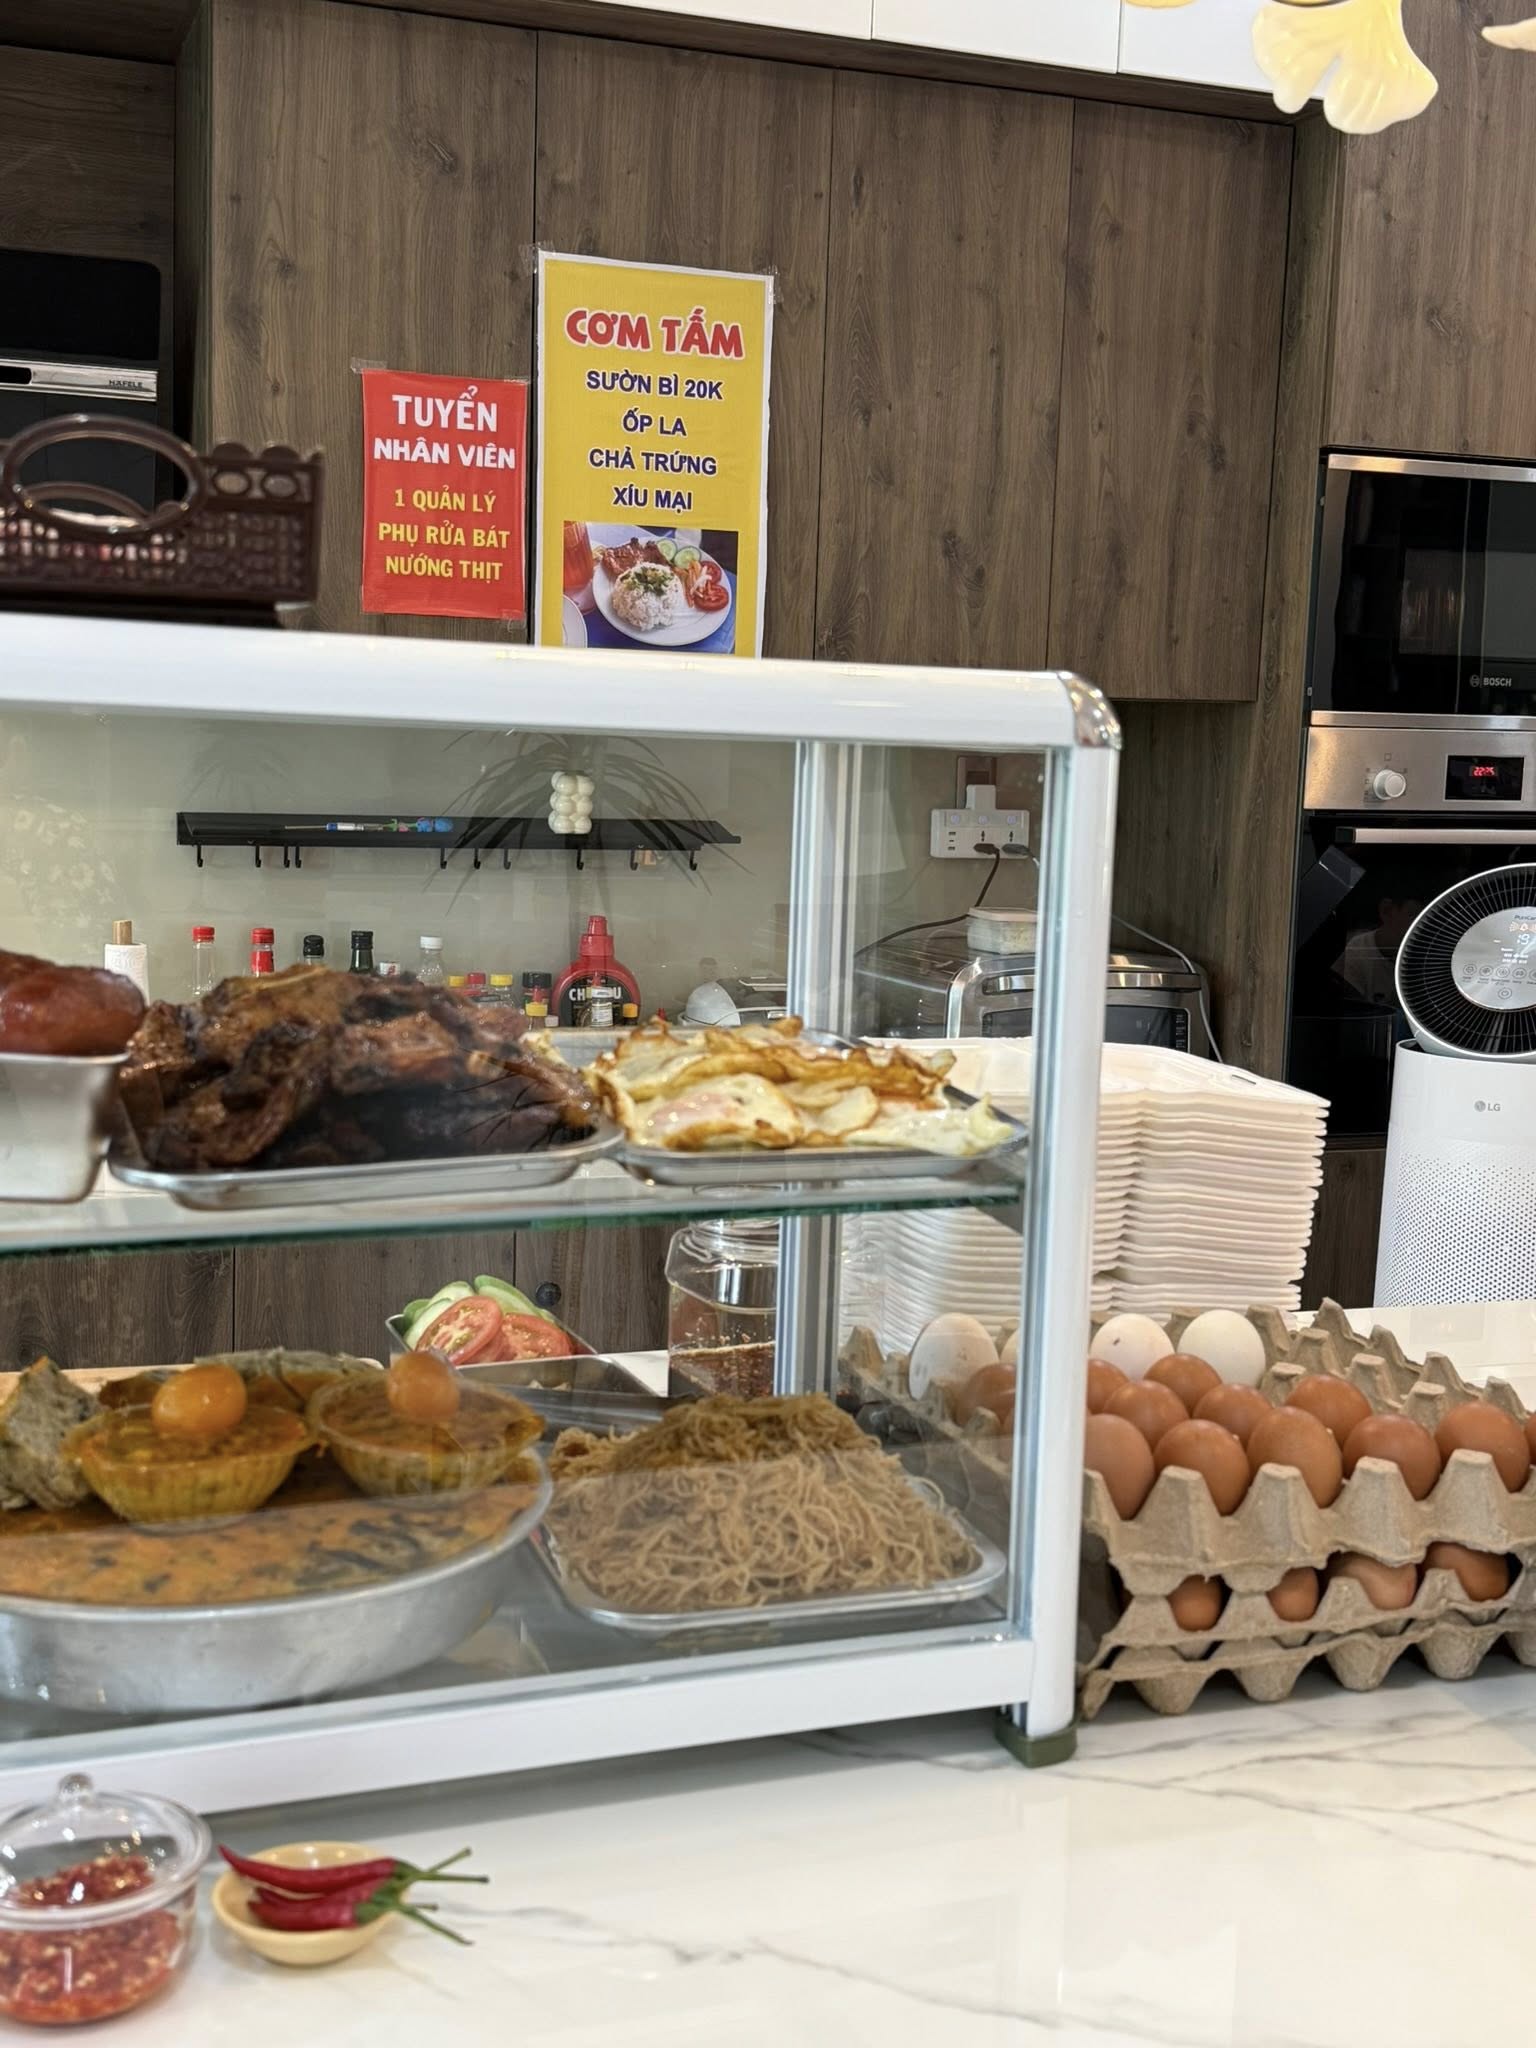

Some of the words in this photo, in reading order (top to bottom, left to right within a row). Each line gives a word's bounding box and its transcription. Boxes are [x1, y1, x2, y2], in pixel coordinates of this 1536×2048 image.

[565, 309, 652, 350] CƠM
[660, 307, 744, 359] TẤM
[586, 370, 651, 394] SƯỜN
[658, 374, 678, 396] BÌ
[684, 379, 723, 400] 20K
[392, 385, 498, 432] TUYỂN
[622, 407, 653, 433] ỐP
[659, 416, 687, 436] LA
[373, 436, 450, 465] NHÂN
[457, 442, 516, 470] VIÊN
[589, 446, 636, 470] CHẢ
[641, 450, 717, 476] TRỨNG
[394, 488, 406, 508] 1
[412, 484, 466, 513] QUẢN
[472, 490, 497, 514] LÝ
[613, 483, 649, 507] XÍU
[655, 490, 692, 514] MẠI
[378, 522, 419, 547] PHỤ
[425, 519, 466, 546] RỬA
[472, 525, 511, 549] BÁT
[385, 553, 454, 578] NƯỚNG
[459, 560, 504, 584] THỊT
[1483, 677, 1512, 687] BOSCH
[1487, 1102, 1501, 1112] LG
